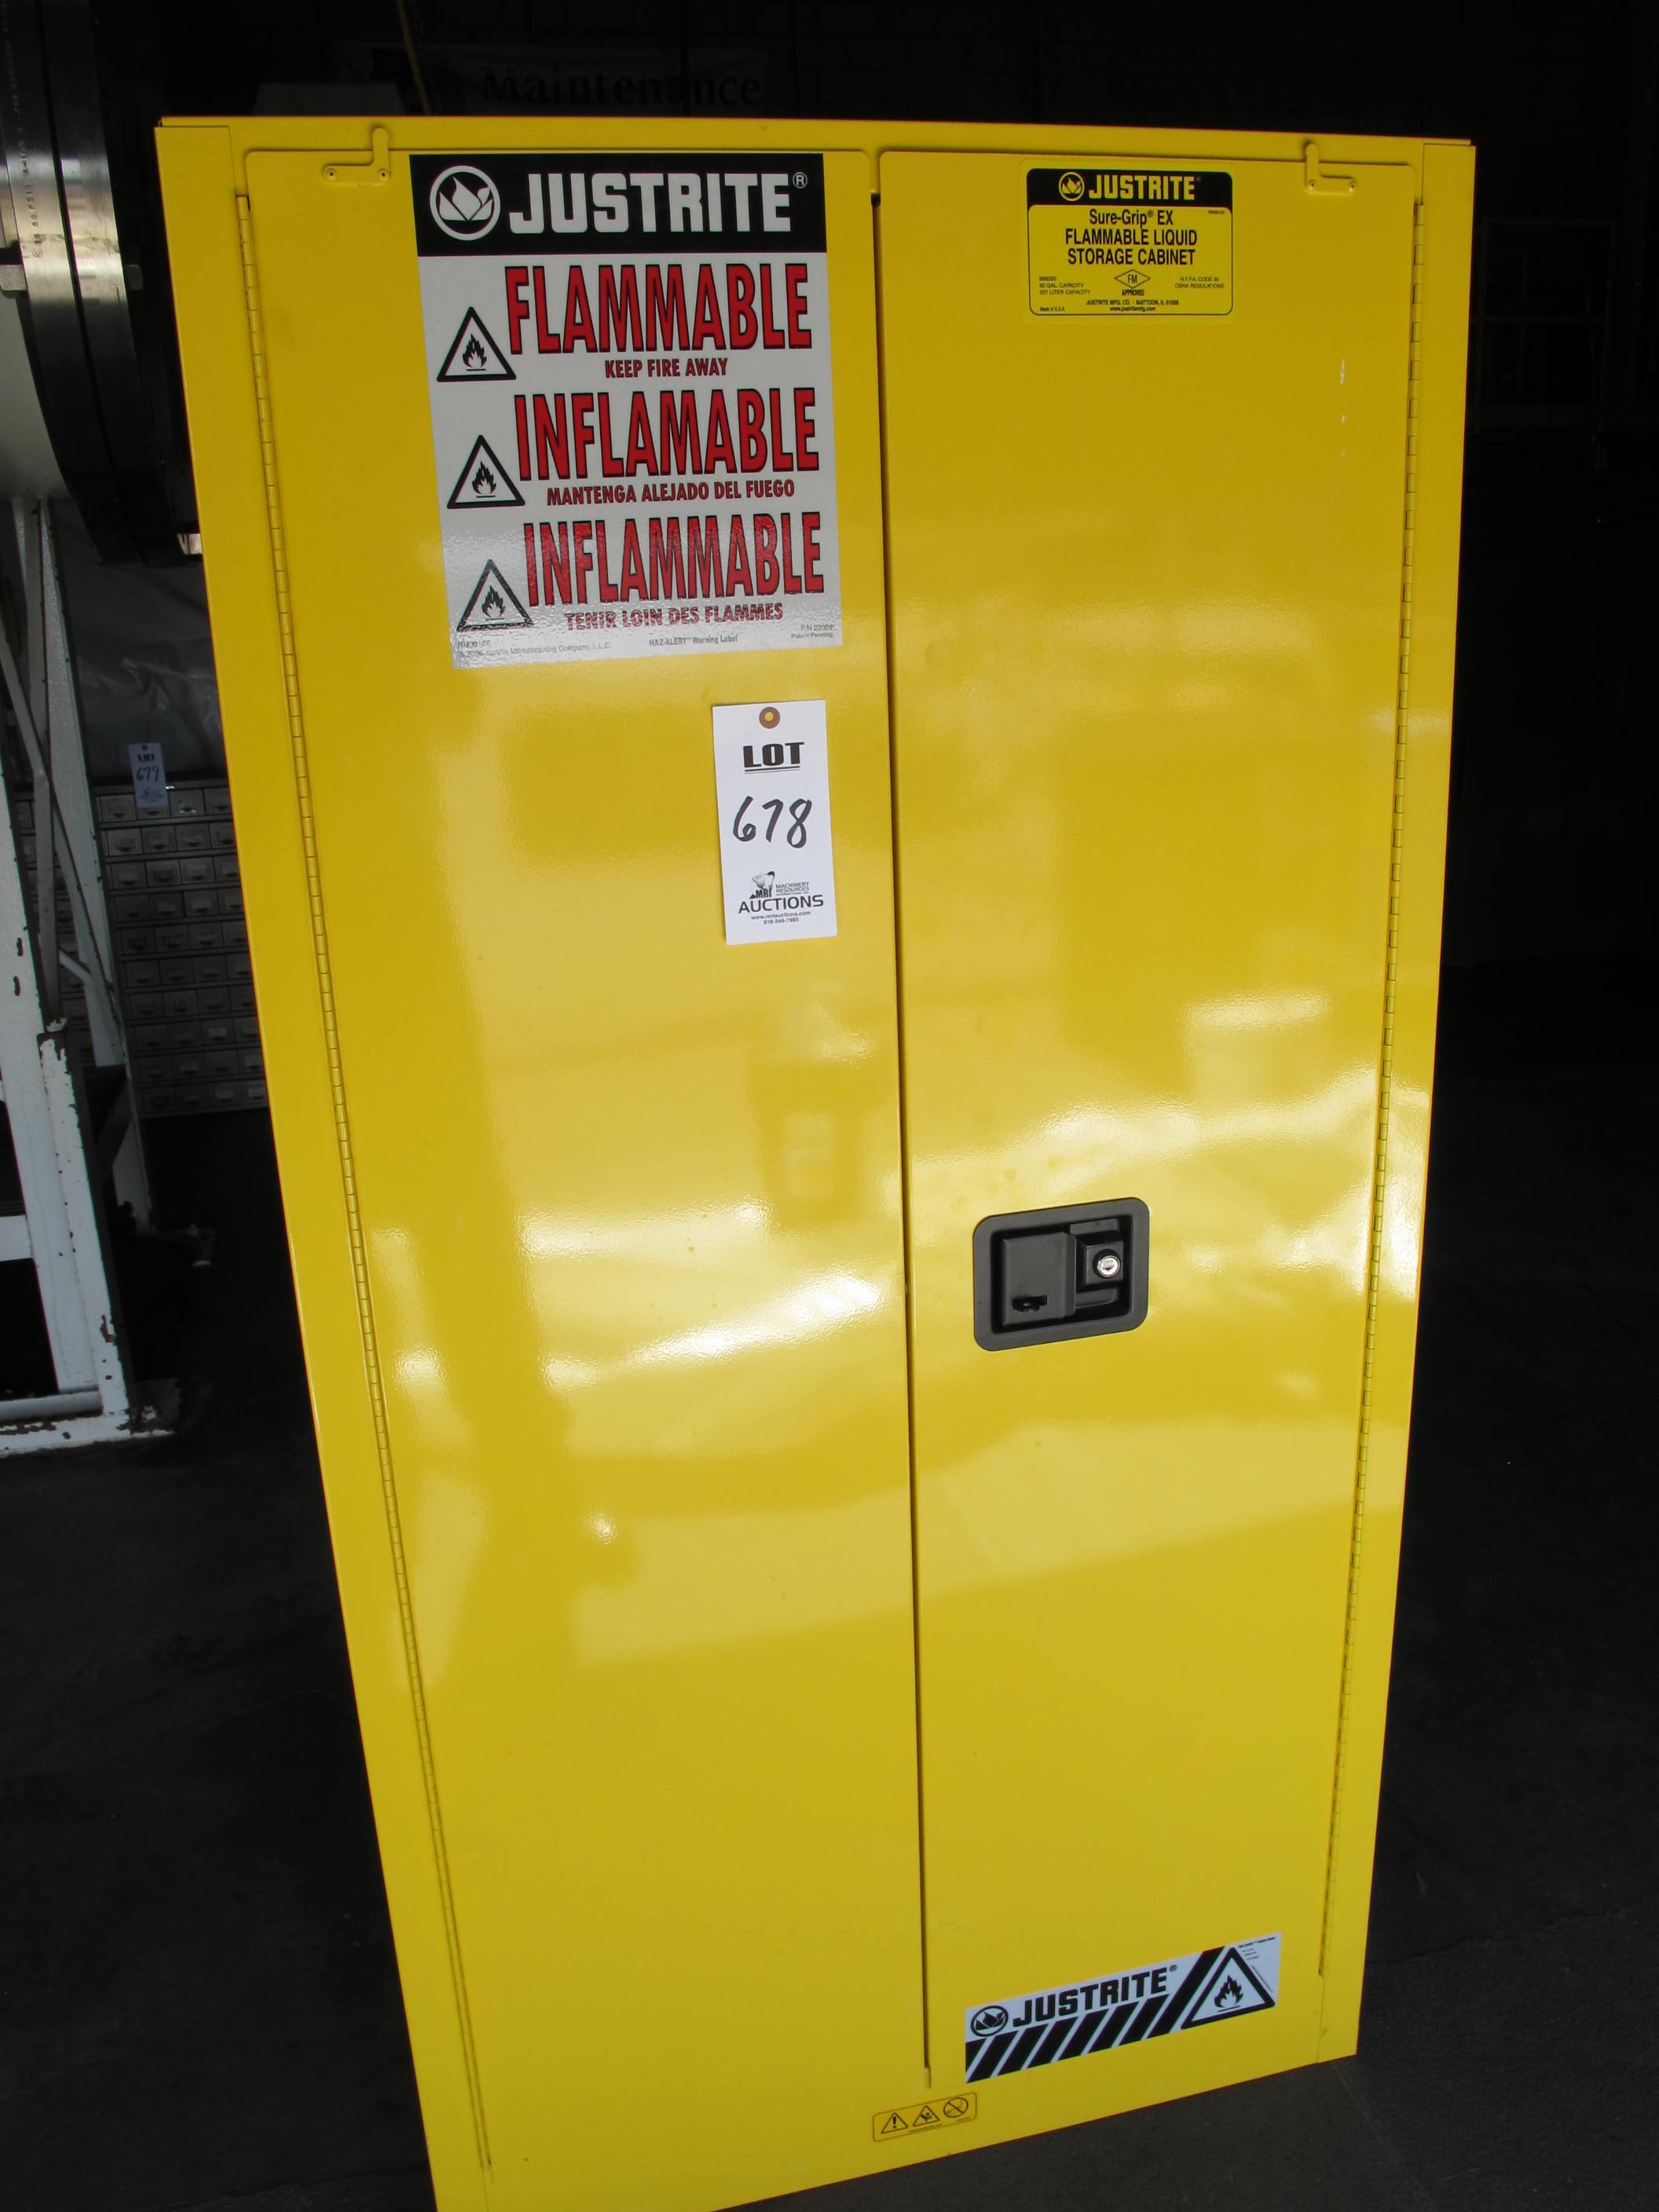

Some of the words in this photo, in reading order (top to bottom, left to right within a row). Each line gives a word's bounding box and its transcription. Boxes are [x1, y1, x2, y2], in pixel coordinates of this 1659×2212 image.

[481, 66, 761, 106] Maintenance
[1157, 210, 1174, 225] EX
[1065, 228, 1149, 245] FLAMMABLE
[1154, 229, 1198, 246] LIQUID
[1068, 248, 1133, 265] STORAGE
[1137, 249, 1196, 266] CABINET
[1127, 274, 1137, 284] FM
[504, 263, 812, 355] FLAMMABLE
[605, 360, 643, 379] KEEP
[647, 359, 680, 377] FIRE
[685, 357, 728, 376] AWAY
[514, 387, 819, 482] INFLAMABLE
[547, 485, 636, 506] MANTENGA
[641, 482, 708, 503] ALEJADO
[714, 481, 742, 500] DEL
[746, 479, 795, 498] FUEGO
[523, 511, 825, 607] INFLAMMABLE
[566, 610, 618, 631] TENIR
[623, 609, 663, 628] LOIN
[668, 607, 699, 625] DES
[705, 603, 784, 624] FLAMMES
[693, 635, 718, 644] Warning
[743, 742, 805, 768] LOT
[733, 795, 812, 848] 678
[738, 894, 824, 914] AUCTIONS
